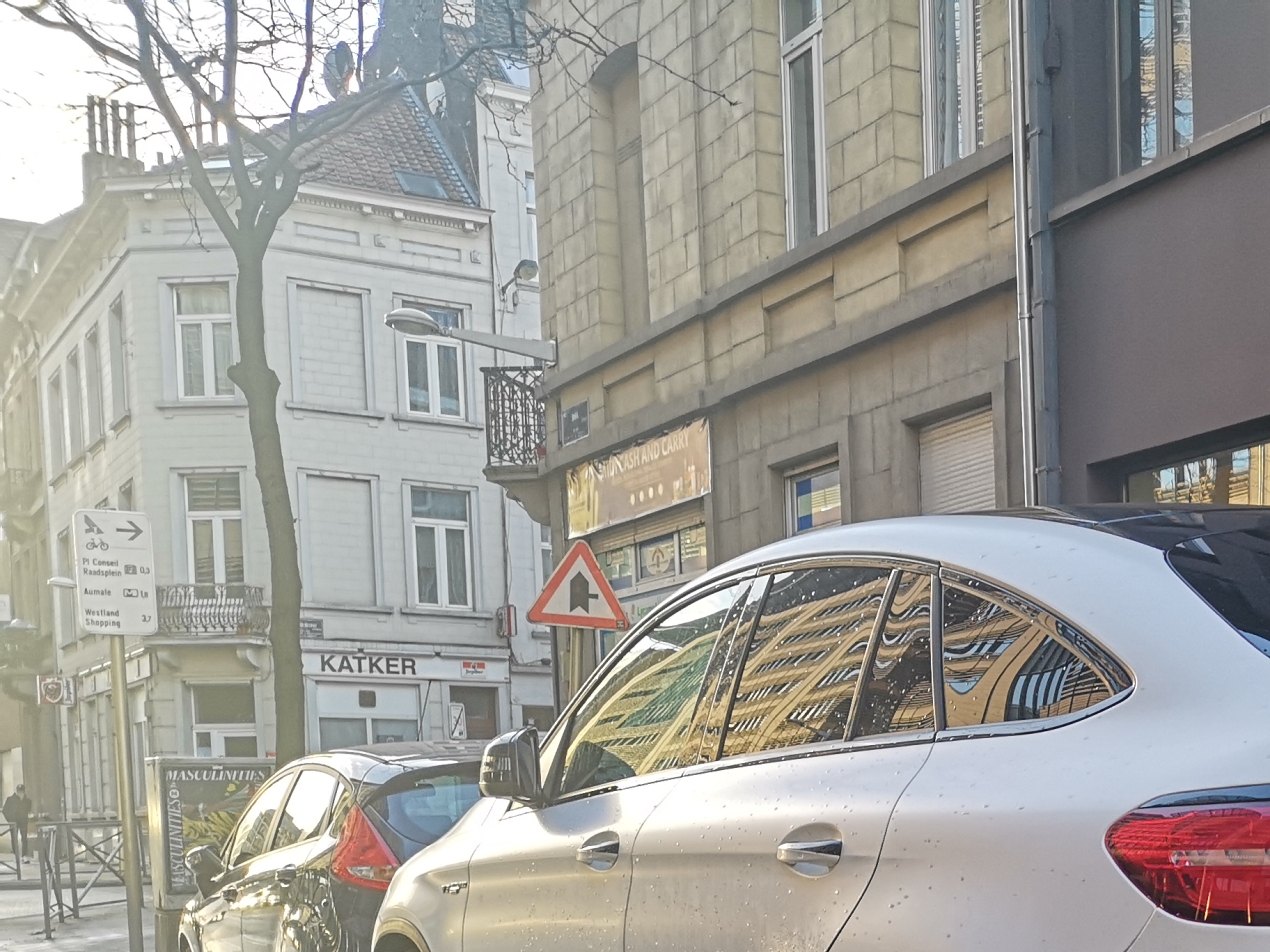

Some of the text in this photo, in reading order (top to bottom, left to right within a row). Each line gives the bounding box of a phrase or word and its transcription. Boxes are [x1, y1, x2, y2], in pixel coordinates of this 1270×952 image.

[641, 440, 660, 464] AND
[661, 428, 690, 455] CARRY
[92, 558, 119, 567] Conseil
[83, 567, 122, 578] Raadsplein
[84, 588, 112, 597] Aumale
[85, 608, 120, 618] Westland
[85, 618, 121, 628] Shopping
[320, 654, 417, 676] KATKER
